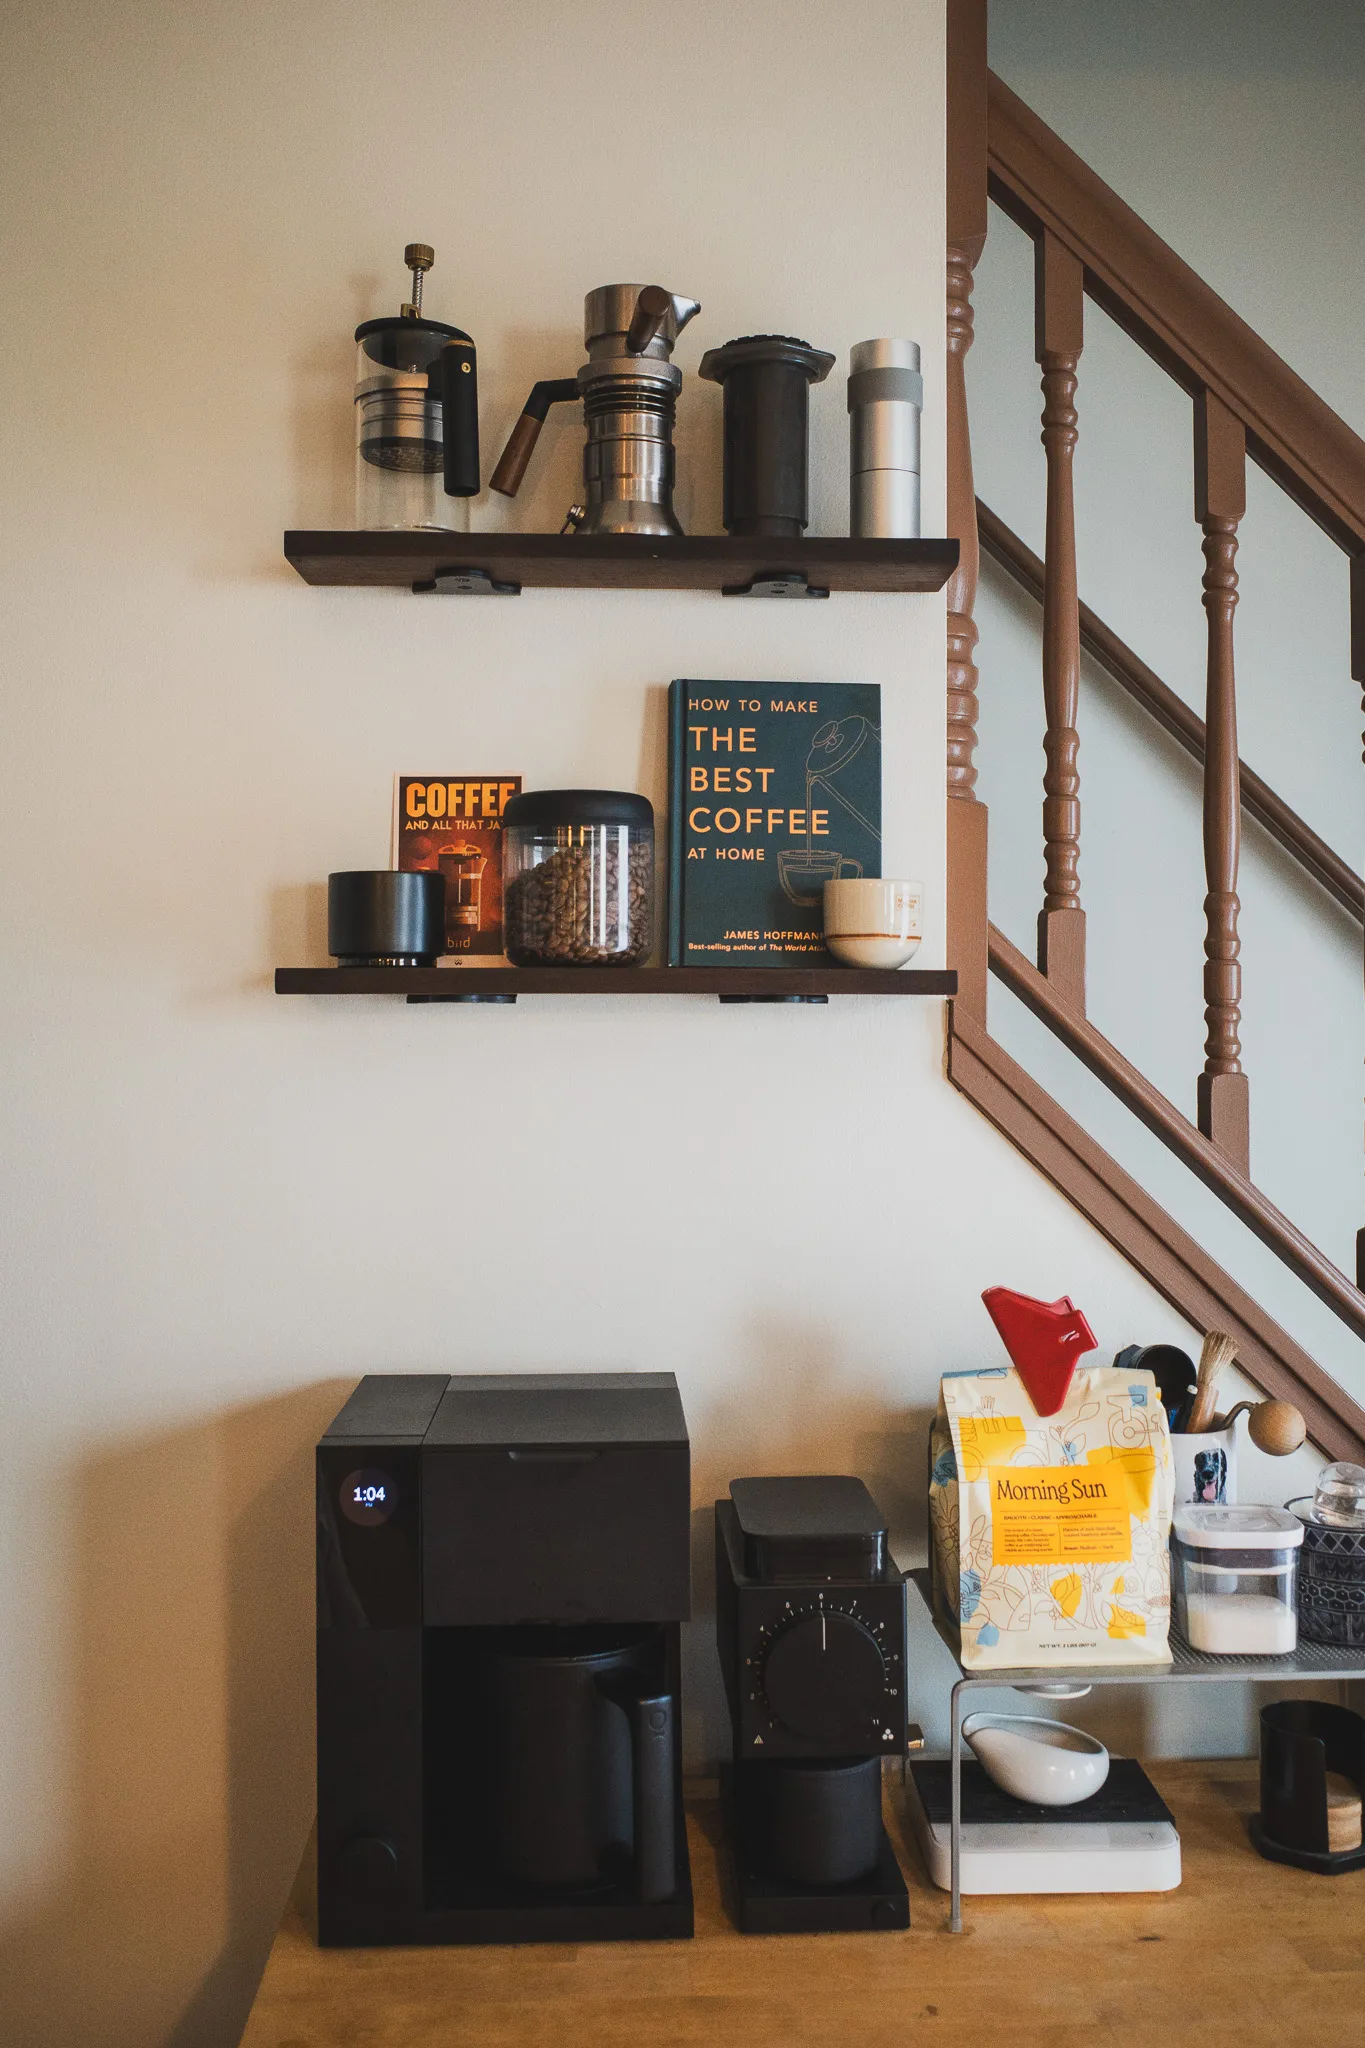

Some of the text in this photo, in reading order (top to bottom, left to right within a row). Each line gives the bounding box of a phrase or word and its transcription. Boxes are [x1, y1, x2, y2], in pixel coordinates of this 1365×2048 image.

[688, 699, 818, 713] HOW TO MAKE
[688, 726, 757, 752] THE
[690, 767, 775, 793] BEST
[405, 820, 504, 831] AND ALL THAT JA
[688, 807, 830, 835] COFFEE
[687, 848, 765, 861] AT HOME
[723, 930, 760, 940] JAMES
[688, 943, 731, 952] Best-selling
[758, 943, 767, 951] of
[785, 944, 806, 952] World
[353, 1486, 386, 1502] 1:04
[997, 1479, 1107, 1504] Morning Sun
[890, 1688, 898, 1696] 10
